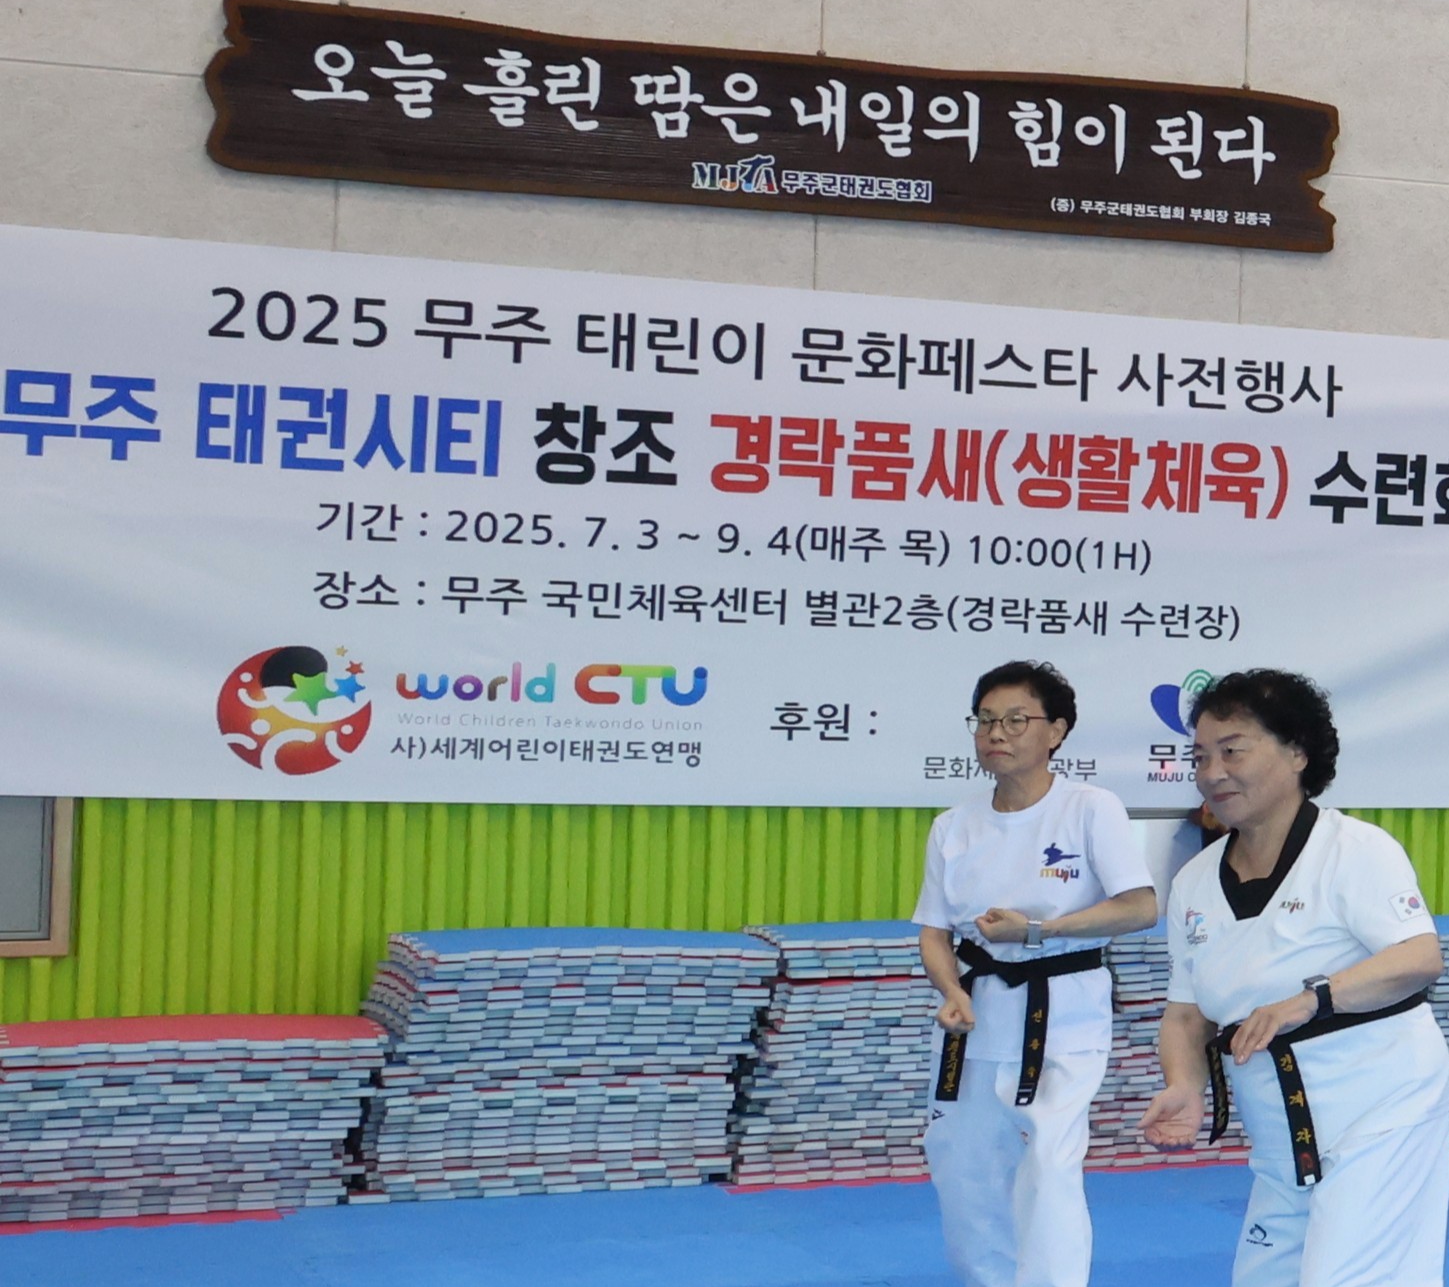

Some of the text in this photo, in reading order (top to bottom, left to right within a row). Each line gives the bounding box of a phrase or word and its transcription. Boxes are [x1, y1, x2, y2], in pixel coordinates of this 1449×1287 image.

[292, 40, 1276, 186] 오늘 흘린 땀은 내일의 힘이 된다
[782, 170, 932, 203] 무주군태권도협회
[1080, 199, 1185, 221] 무주군태권도협회
[1190, 208, 1228, 224] 부회장
[208, 287, 1343, 419] 2025 무주 태린이 문화페스타 사전행사
[0, 368, 162, 462] 무주
[195, 381, 502, 478] 태권시티
[533, 401, 678, 486] 창조
[709, 413, 1289, 520] 경락품새(생활체육)
[316, 502, 403, 543] 기간
[445, 510, 567, 549] 2025.
[584, 516, 620, 551] 7.
[636, 519, 660, 551] 3
[717, 523, 753, 557] 9.
[767, 524, 887, 564] 4(매주
[899, 528, 951, 568] 목)
[968, 535, 1152, 576] 10:00(1H)
[313, 570, 400, 610] 장소
[442, 576, 527, 616] 무주
[542, 579, 788, 626] 국민체육센터
[805, 589, 1108, 636] 별관2층(경락품새
[1120, 600, 1241, 642] 수련장)
[396, 661, 708, 706] world CTU
[398, 713, 703, 731] World Children Taekwondo Union
[770, 702, 851, 742] 후원
[390, 736, 702, 768] 사)세계어린이태권도연맹
[1147, 772, 1184, 783] MUJU
[1040, 865, 1080, 884] muju
